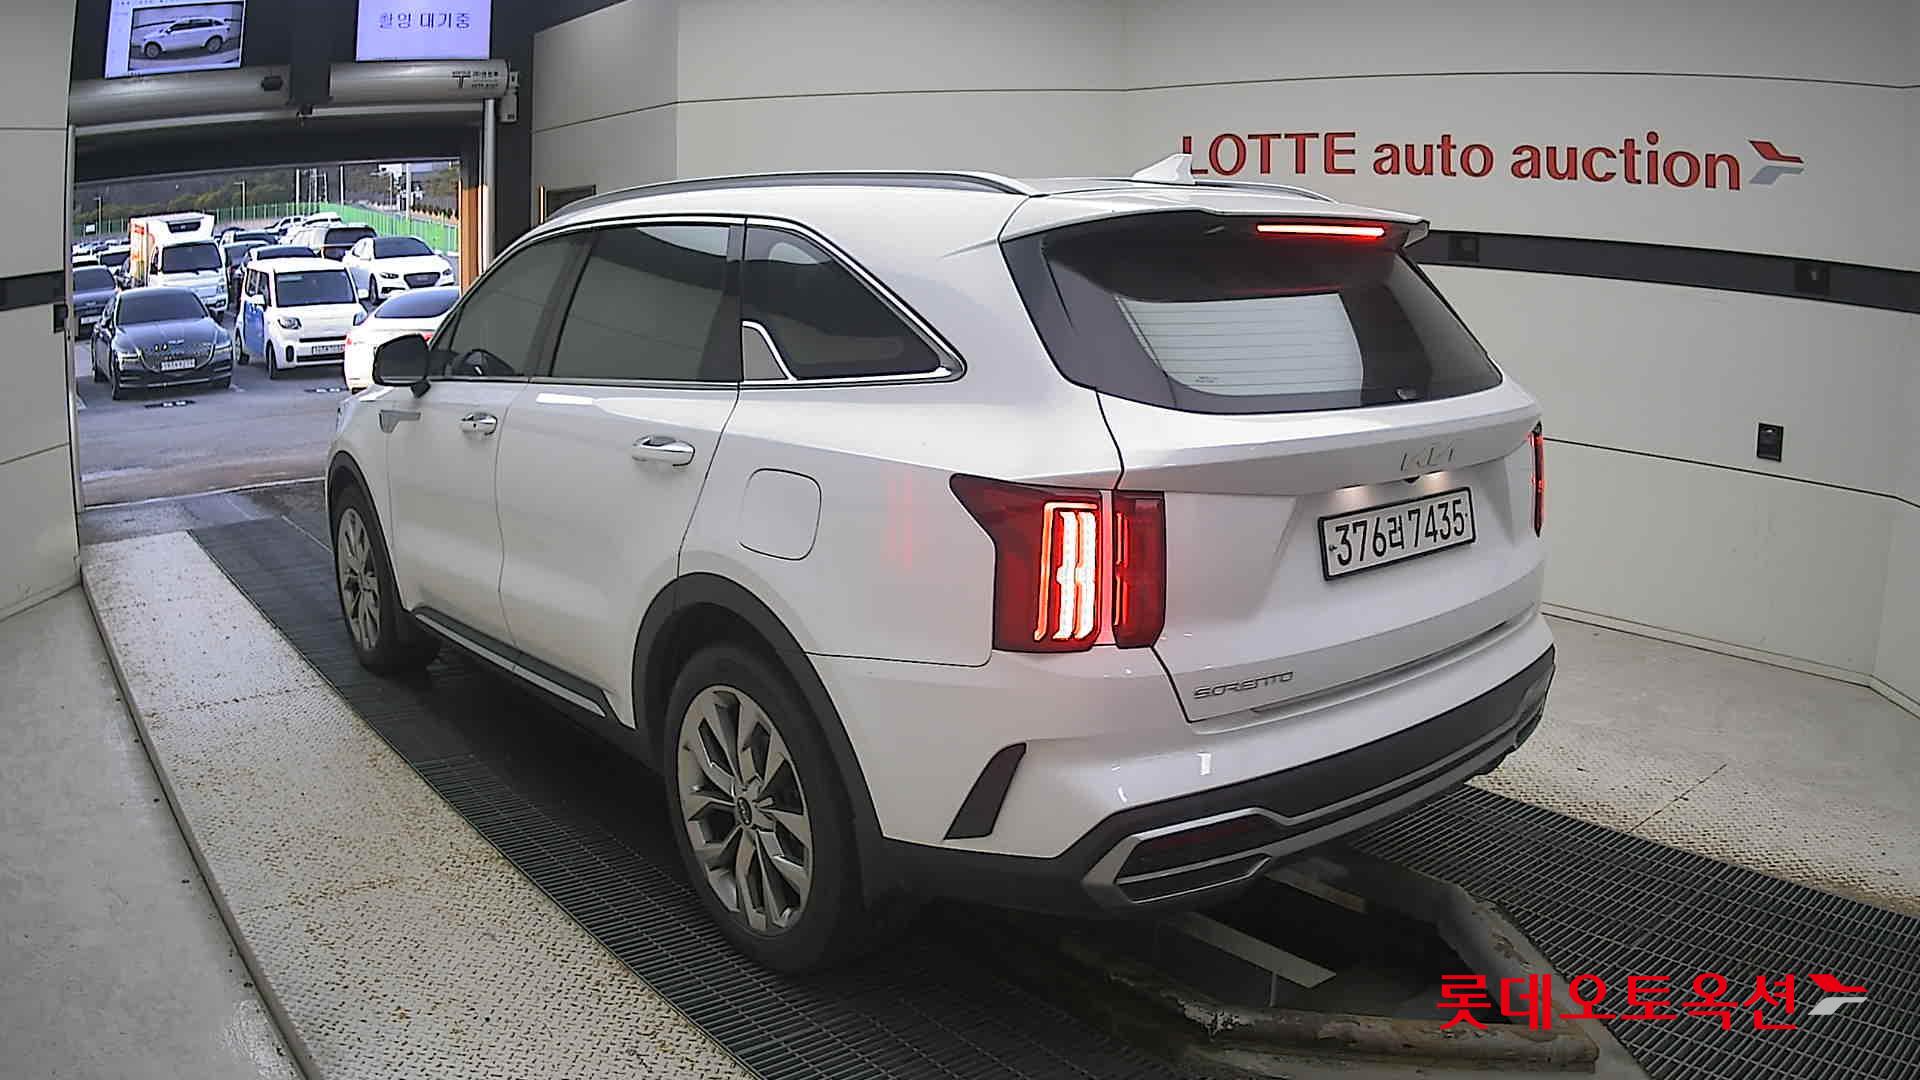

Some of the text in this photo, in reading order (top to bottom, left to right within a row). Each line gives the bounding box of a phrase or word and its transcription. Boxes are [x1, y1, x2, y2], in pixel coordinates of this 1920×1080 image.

[420, 12, 470, 29] 대기중
[1183, 131, 1741, 190] LOTTE auto auction
[1335, 498, 1466, 566] 376러 7435
[1193, 671, 1294, 700] SORENTO
